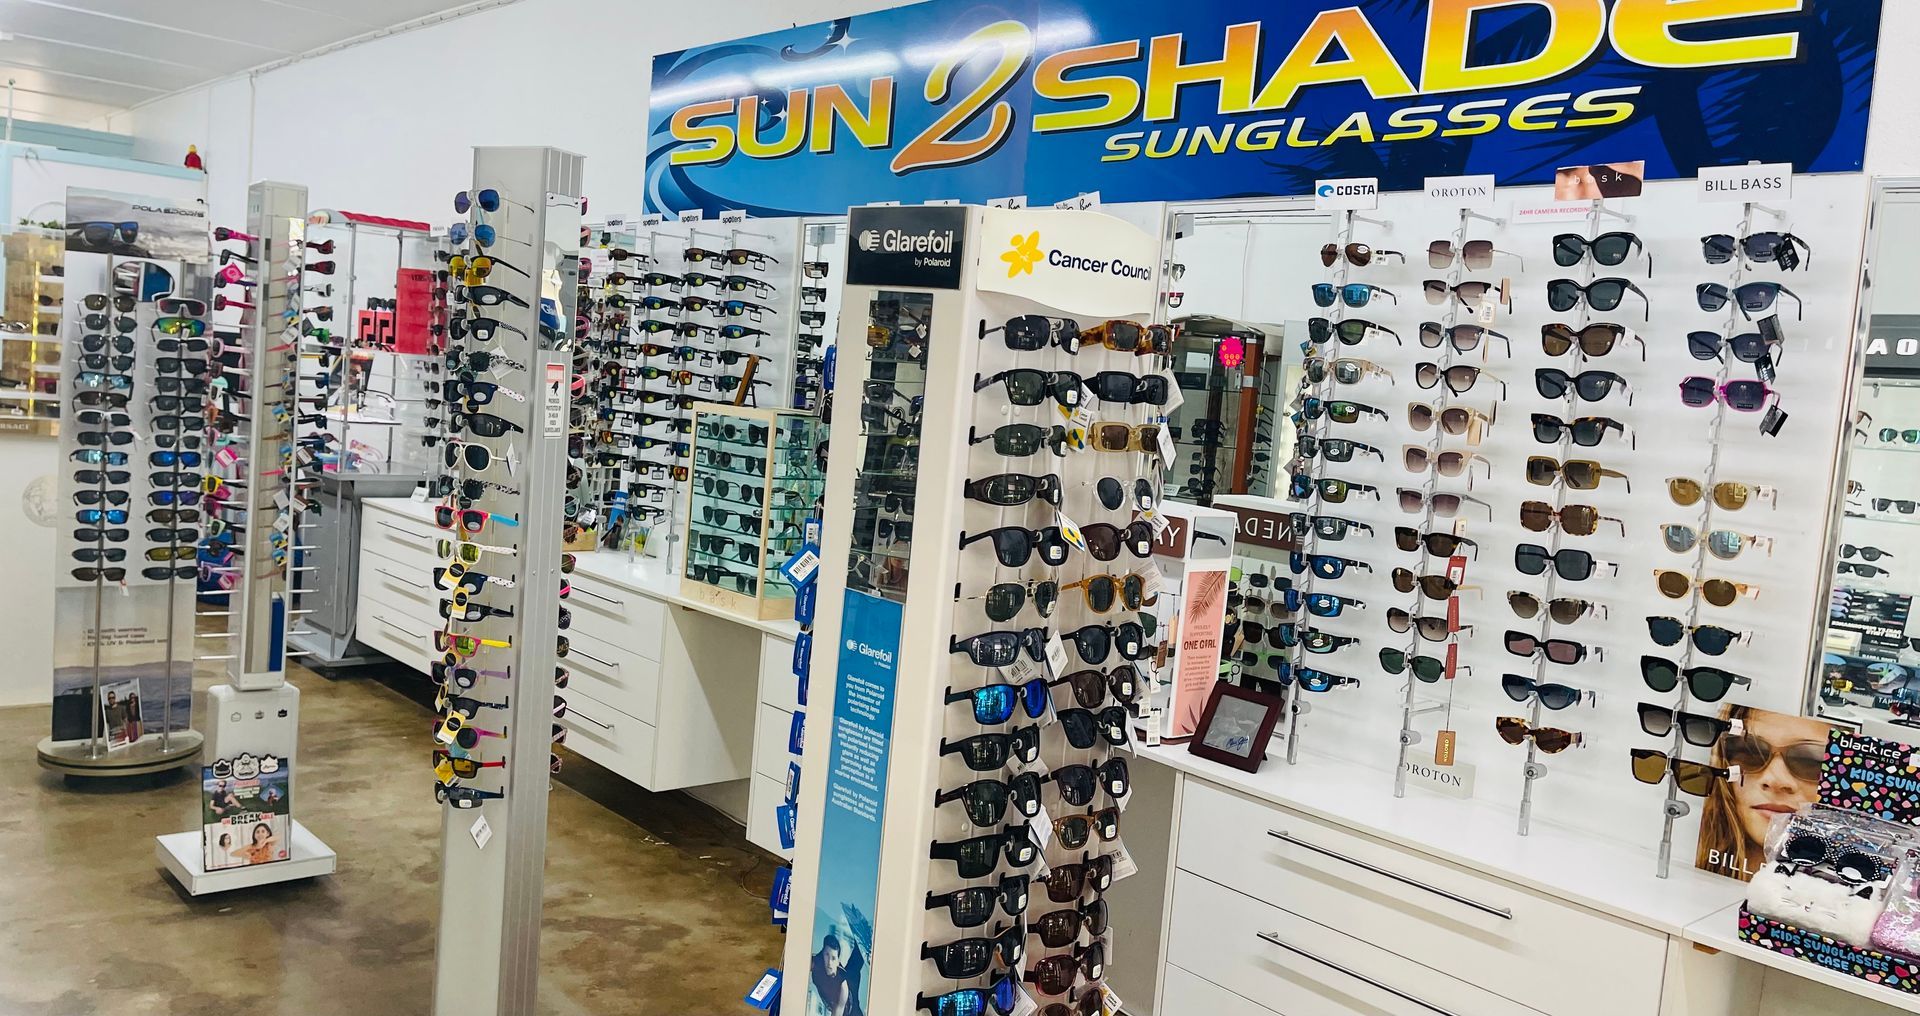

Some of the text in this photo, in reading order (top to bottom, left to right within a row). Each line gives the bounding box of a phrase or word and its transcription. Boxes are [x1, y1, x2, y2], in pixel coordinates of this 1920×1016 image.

[669, 75, 895, 166] SUN
[890, 19, 1033, 175] 2
[1100, 86, 1642, 163] SUNGLASSES
[1336, 184, 1376, 196] COSTA
[1431, 186, 1487, 198] OROTON
[1705, 177, 1782, 192] BILL BASS
[883, 229, 954, 254] Glarefoil
[914, 257, 951, 268] by Polaroid
[1048, 249, 1152, 281] Cancer Counci
[858, 643, 892, 664] Glarefoil
[1183, 639, 1217, 650] ONE GIRL
[1840, 736, 1902, 759] black ice
[1849, 767, 1885, 785] KIDS
[1708, 848, 1754, 875] BILL
[1770, 927, 1889, 972] KIDS SUNGLASSES
[1816, 953, 1849, 971] CASE
